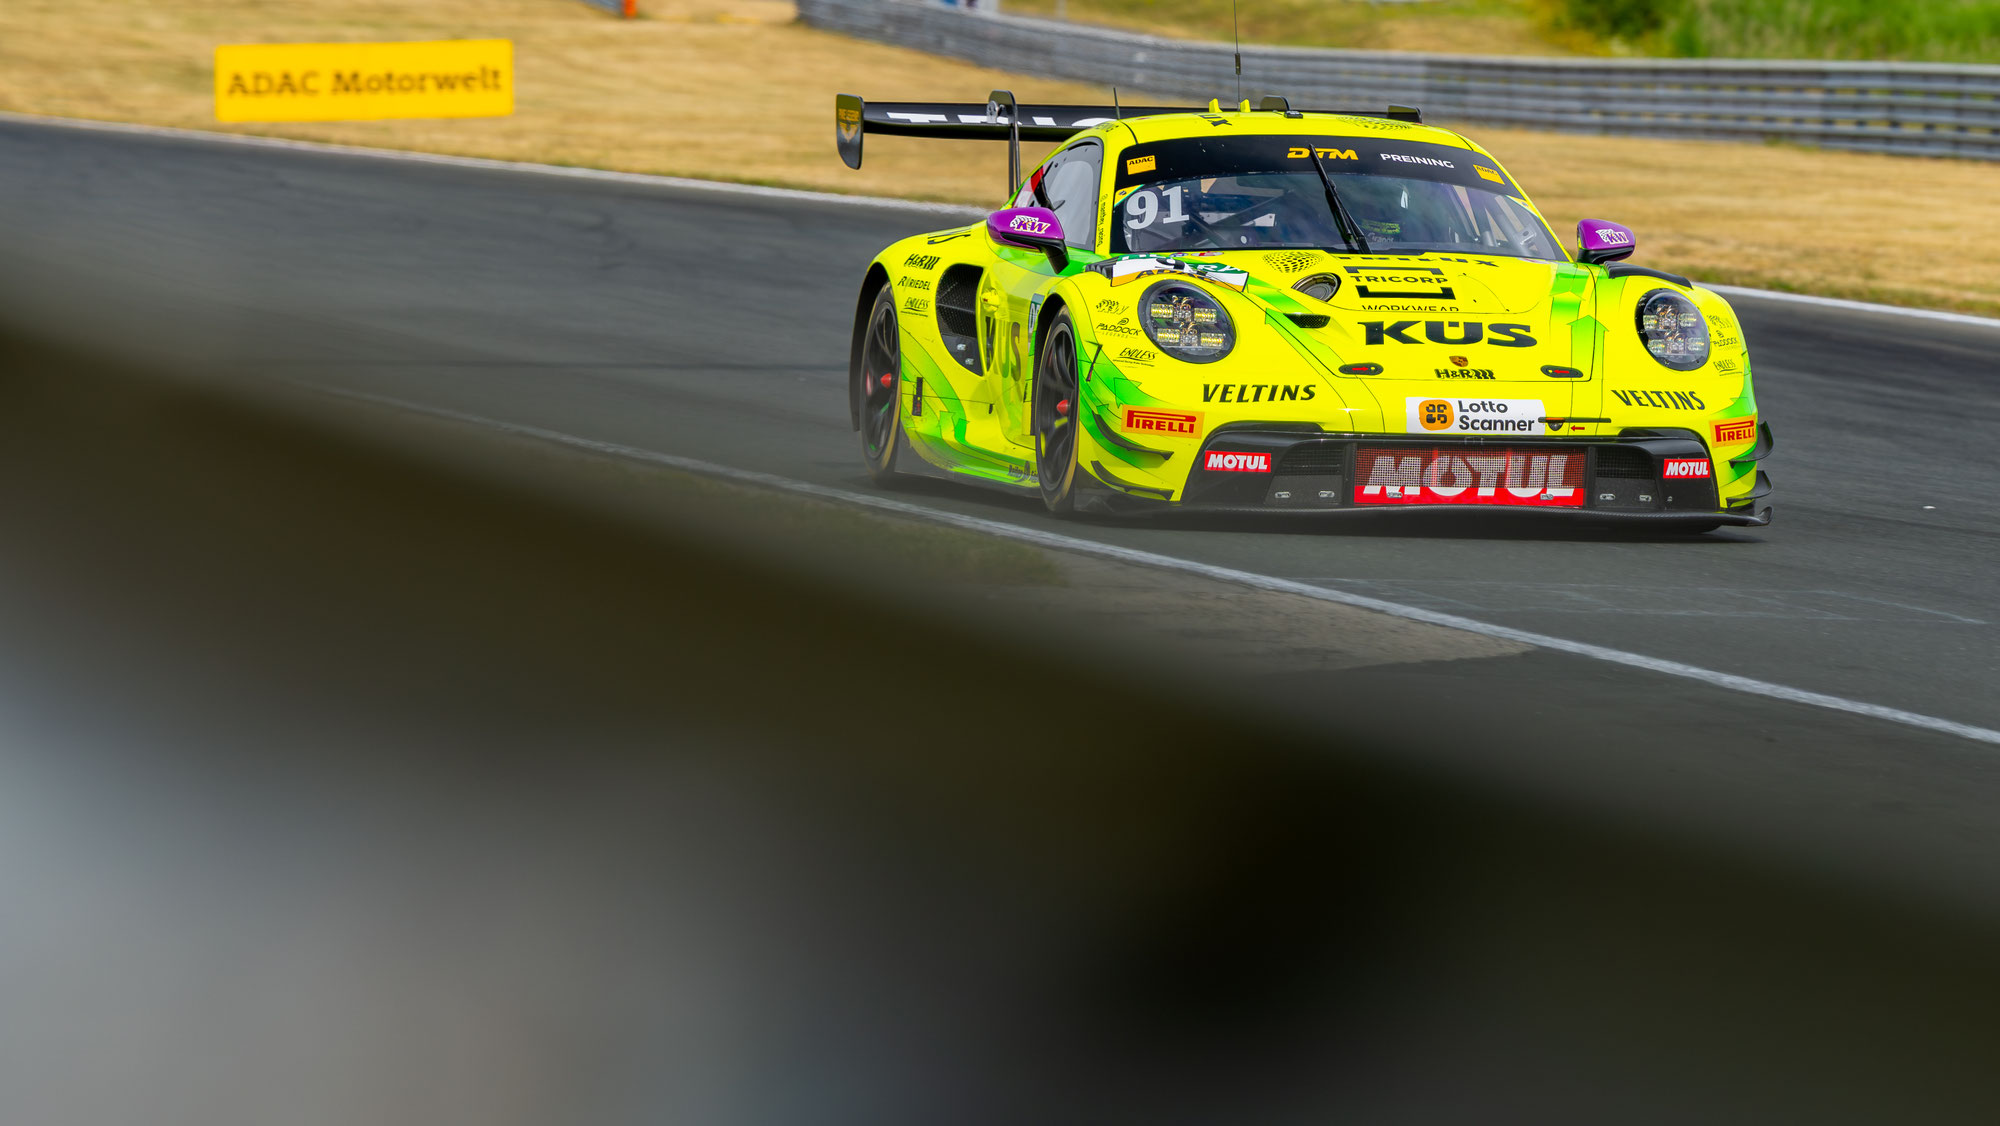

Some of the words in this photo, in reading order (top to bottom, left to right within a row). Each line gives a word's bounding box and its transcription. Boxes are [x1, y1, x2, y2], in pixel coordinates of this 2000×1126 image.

[226, 71, 321, 96] ADAC
[331, 65, 503, 95] Motorwelt
[1128, 156, 1154, 166] ADAC
[1287, 147, 1359, 161] DTM
[1379, 153, 1455, 169] PREINING
[1126, 185, 1190, 230] 91
[1015, 220, 1050, 233] KW
[1606, 231, 1629, 244] KW
[1350, 275, 1449, 284] TRICORP
[1096, 323, 1142, 336] PADDOCK
[1357, 320, 1538, 348] KÜS
[1119, 347, 1159, 360] ENDLESS
[1202, 384, 1317, 403] VELTINS
[1610, 389, 1706, 411] VELTINS
[1457, 400, 1509, 413] Lotto
[1126, 409, 1197, 434] PIRELLI
[1458, 415, 1535, 432] Scanner
[1714, 419, 1755, 443] PIRELLI
[1207, 453, 1268, 470] MOTUL
[1665, 461, 1709, 476] MOTUL
[1363, 455, 1576, 498] MOTUL
